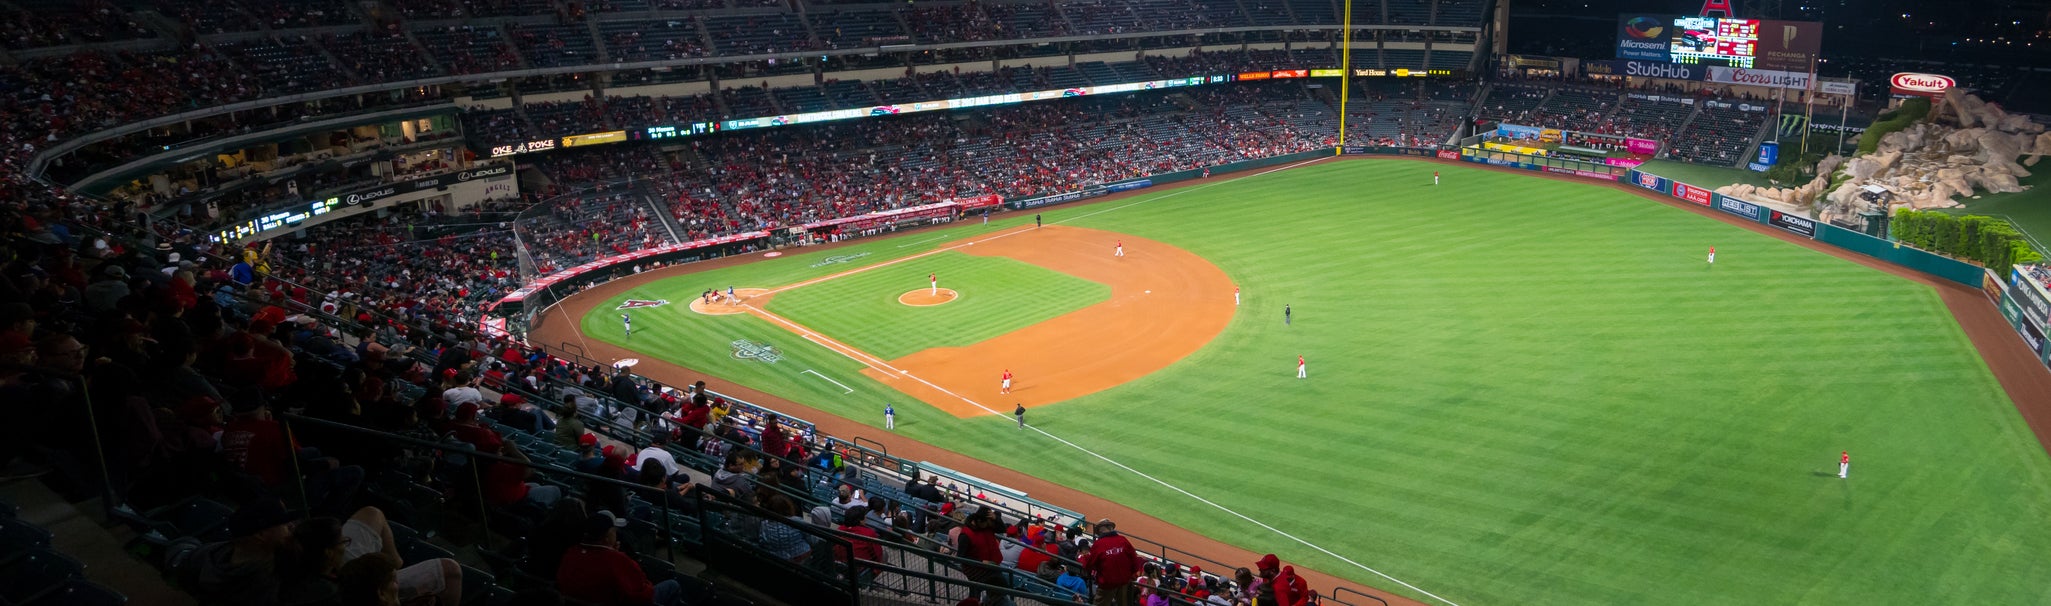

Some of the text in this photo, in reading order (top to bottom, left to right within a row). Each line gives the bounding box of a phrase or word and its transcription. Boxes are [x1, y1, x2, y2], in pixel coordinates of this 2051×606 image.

[1620, 40, 1666, 50] Microsemi
[1626, 61, 1690, 79] StubHub
[1732, 68, 1808, 87] Coors LIGHT
[1903, 77, 1944, 88] Yakult
[492, 140, 555, 155] OKE POKE
[471, 167, 507, 177] LEXUS
[360, 188, 395, 200] LEXUS
[485, 184, 511, 196] ANGELS
[1782, 214, 1813, 229] YOKOHAMA
